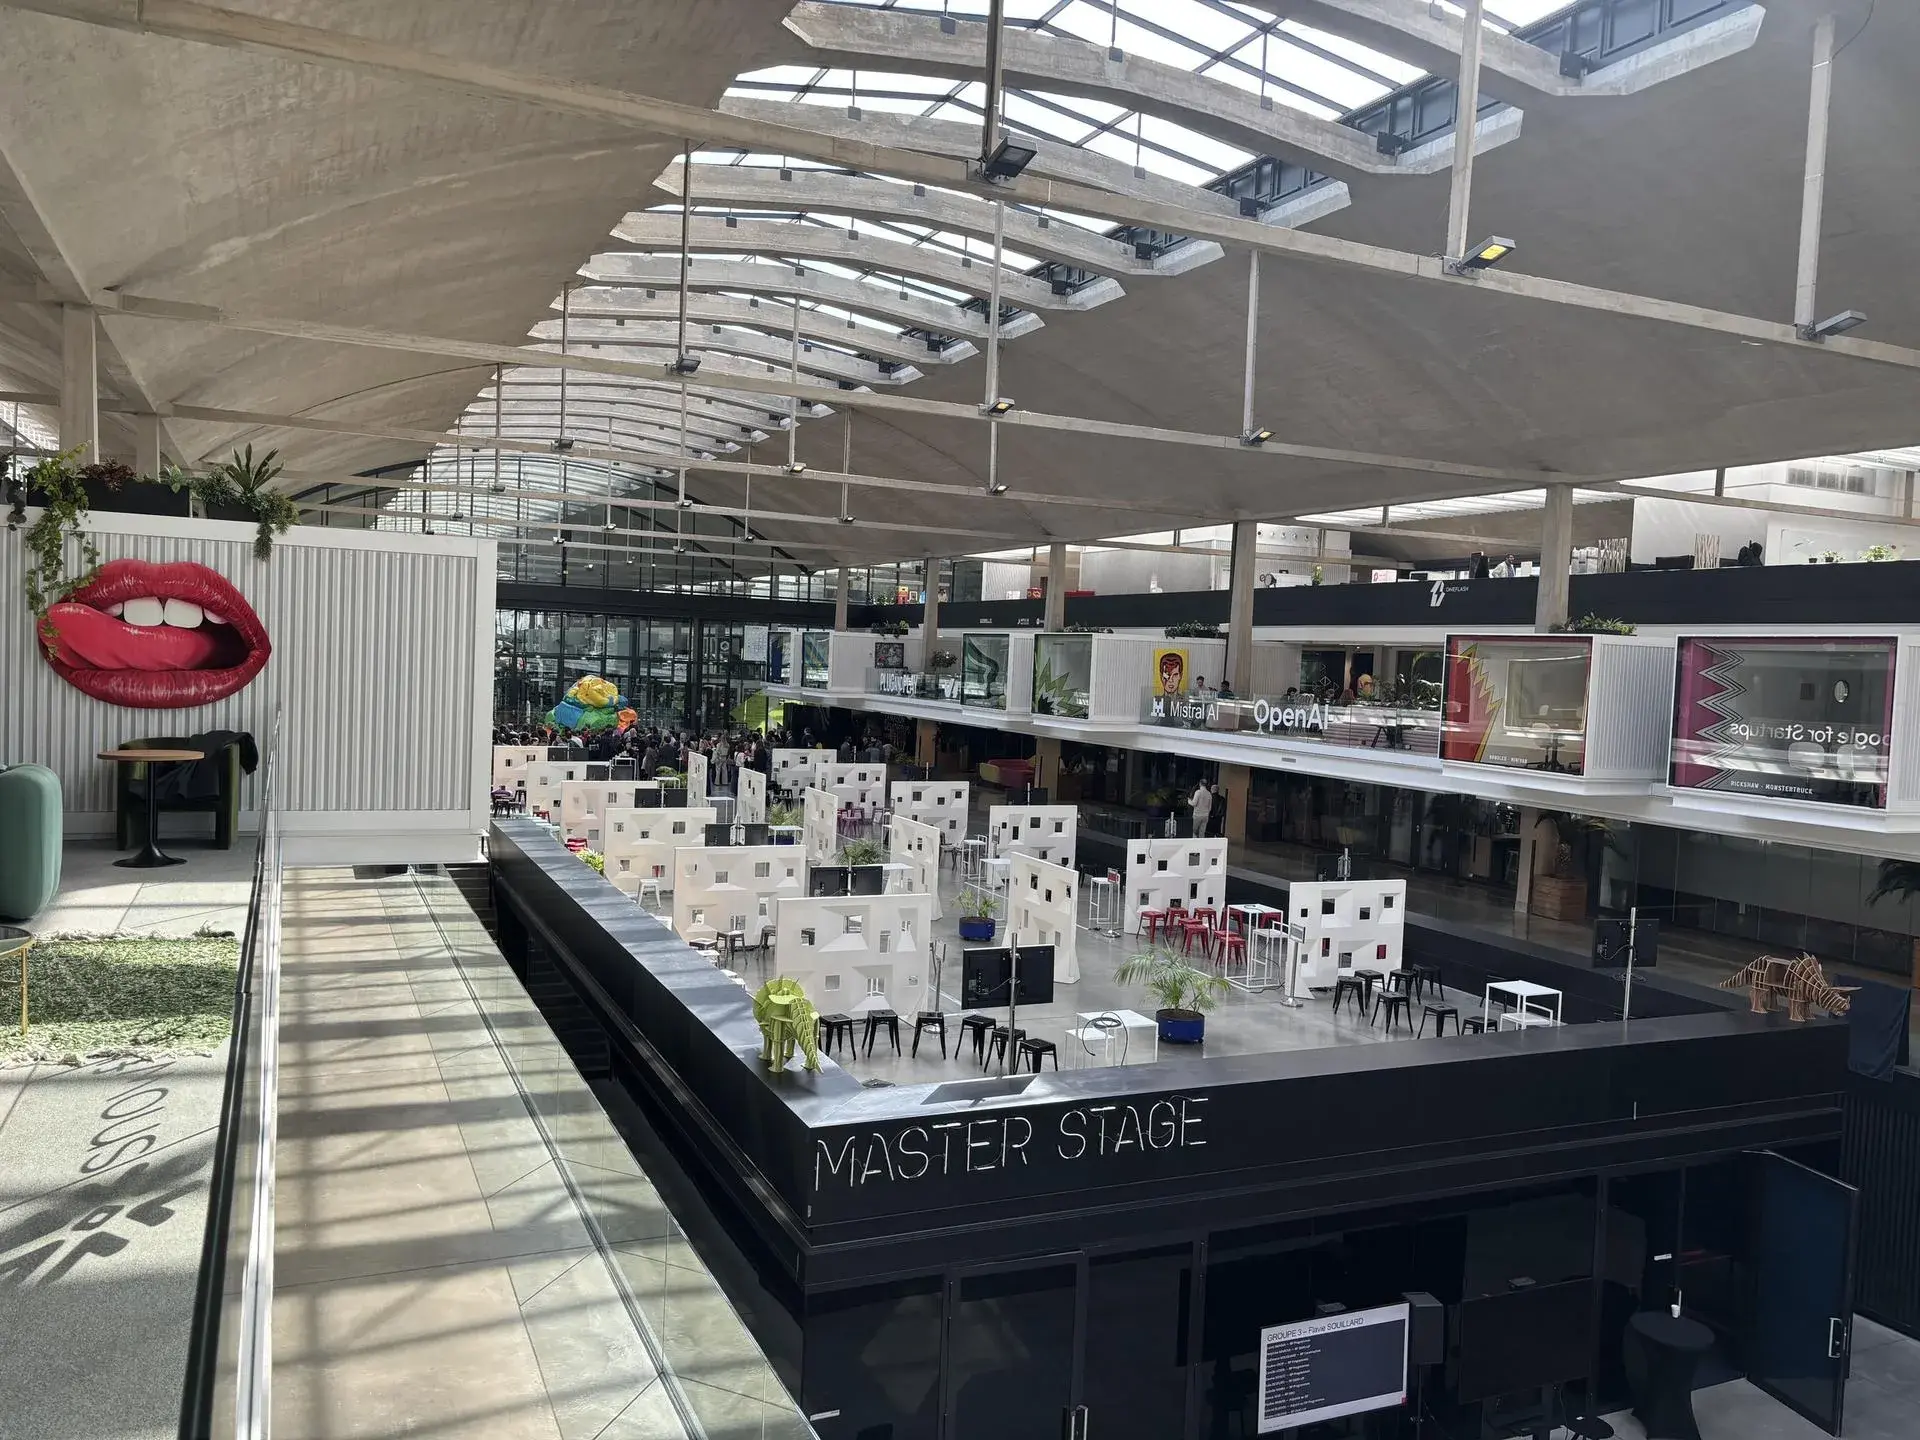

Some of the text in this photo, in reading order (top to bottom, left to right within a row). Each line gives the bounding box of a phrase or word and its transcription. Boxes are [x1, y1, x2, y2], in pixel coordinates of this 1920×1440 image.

[1170, 701, 1219, 721] Mistral AI
[1253, 699, 1329, 730] OpenAI
[1730, 780, 1759, 790] RICKSHAW
[1765, 784, 1813, 795] MONSTERTRUCK
[815, 1094, 1209, 1191] MASTER STAGE
[1266, 1329, 1297, 1342] GROUPE
[1326, 1317, 1364, 1331] SOUILLARD
